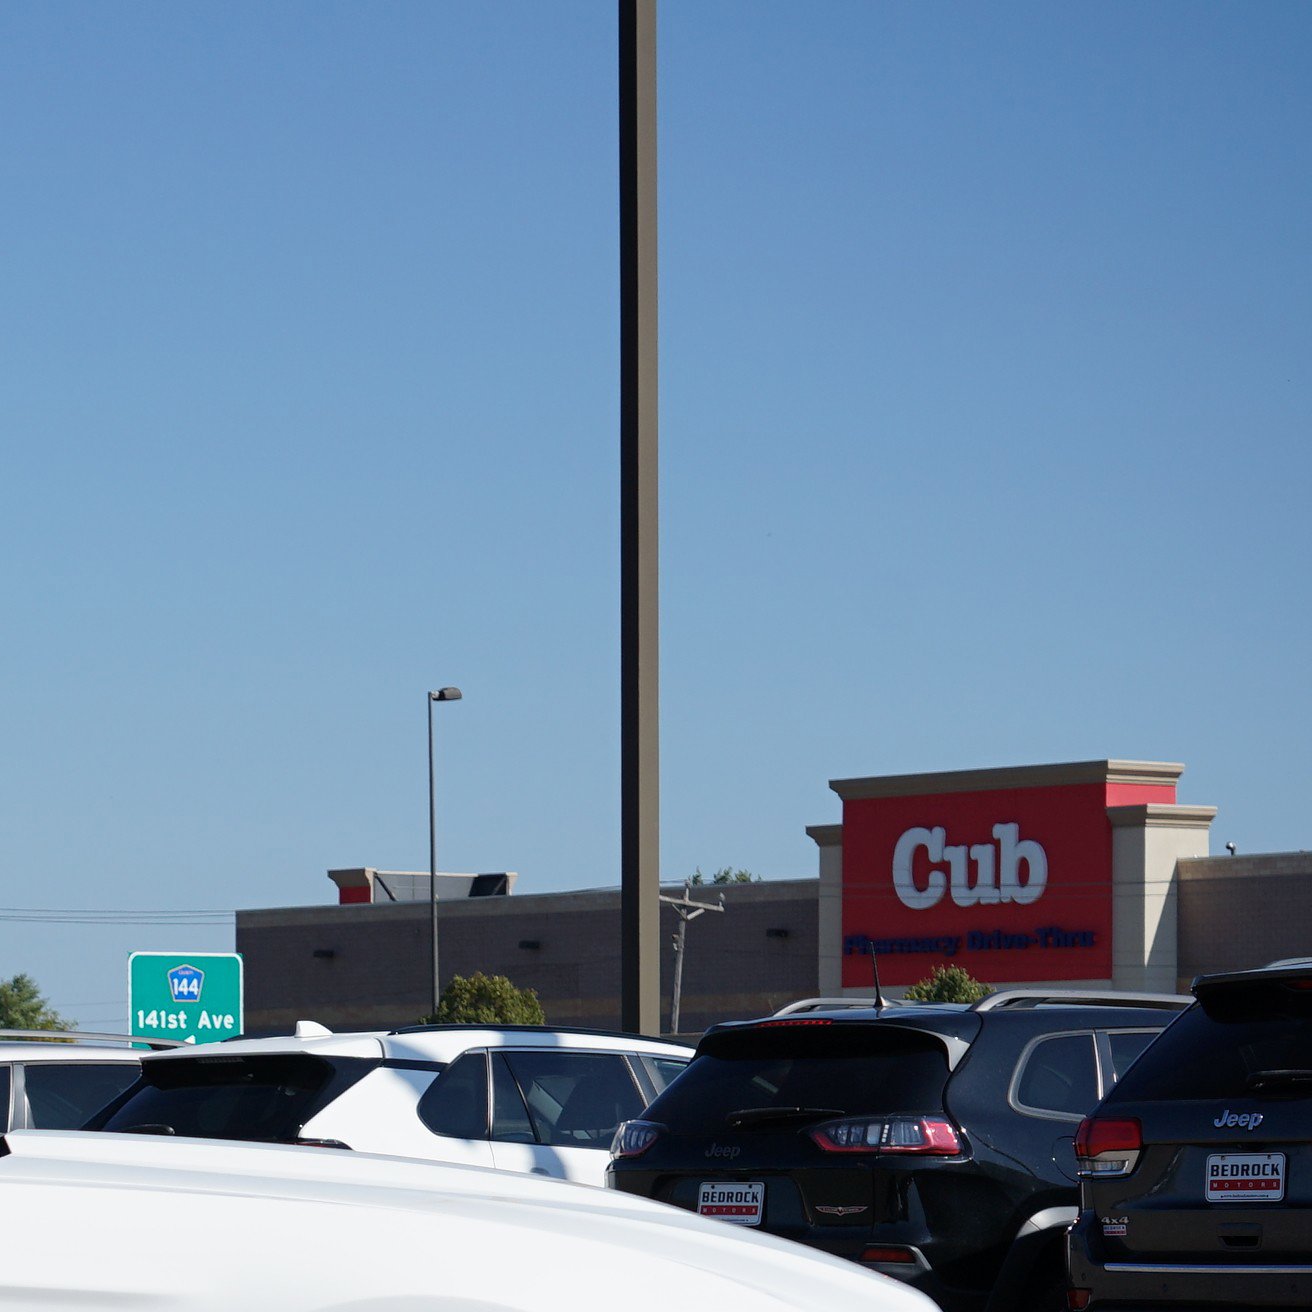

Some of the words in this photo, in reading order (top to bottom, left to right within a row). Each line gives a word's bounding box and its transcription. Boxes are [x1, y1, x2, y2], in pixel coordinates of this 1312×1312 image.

[893, 822, 1048, 910] Cub
[844, 934, 962, 957] Pharmacy
[173, 978, 198, 996] 144
[138, 1010, 187, 1029] 141st
[198, 1010, 234, 1029] Ave
[1214, 1110, 1263, 1130] Jeep
[705, 1142, 741, 1160] Jeep
[1211, 1164, 1280, 1177] BEDROCK
[702, 1191, 759, 1203] BEDROCK
[1101, 1216, 1129, 1224] 4x4
